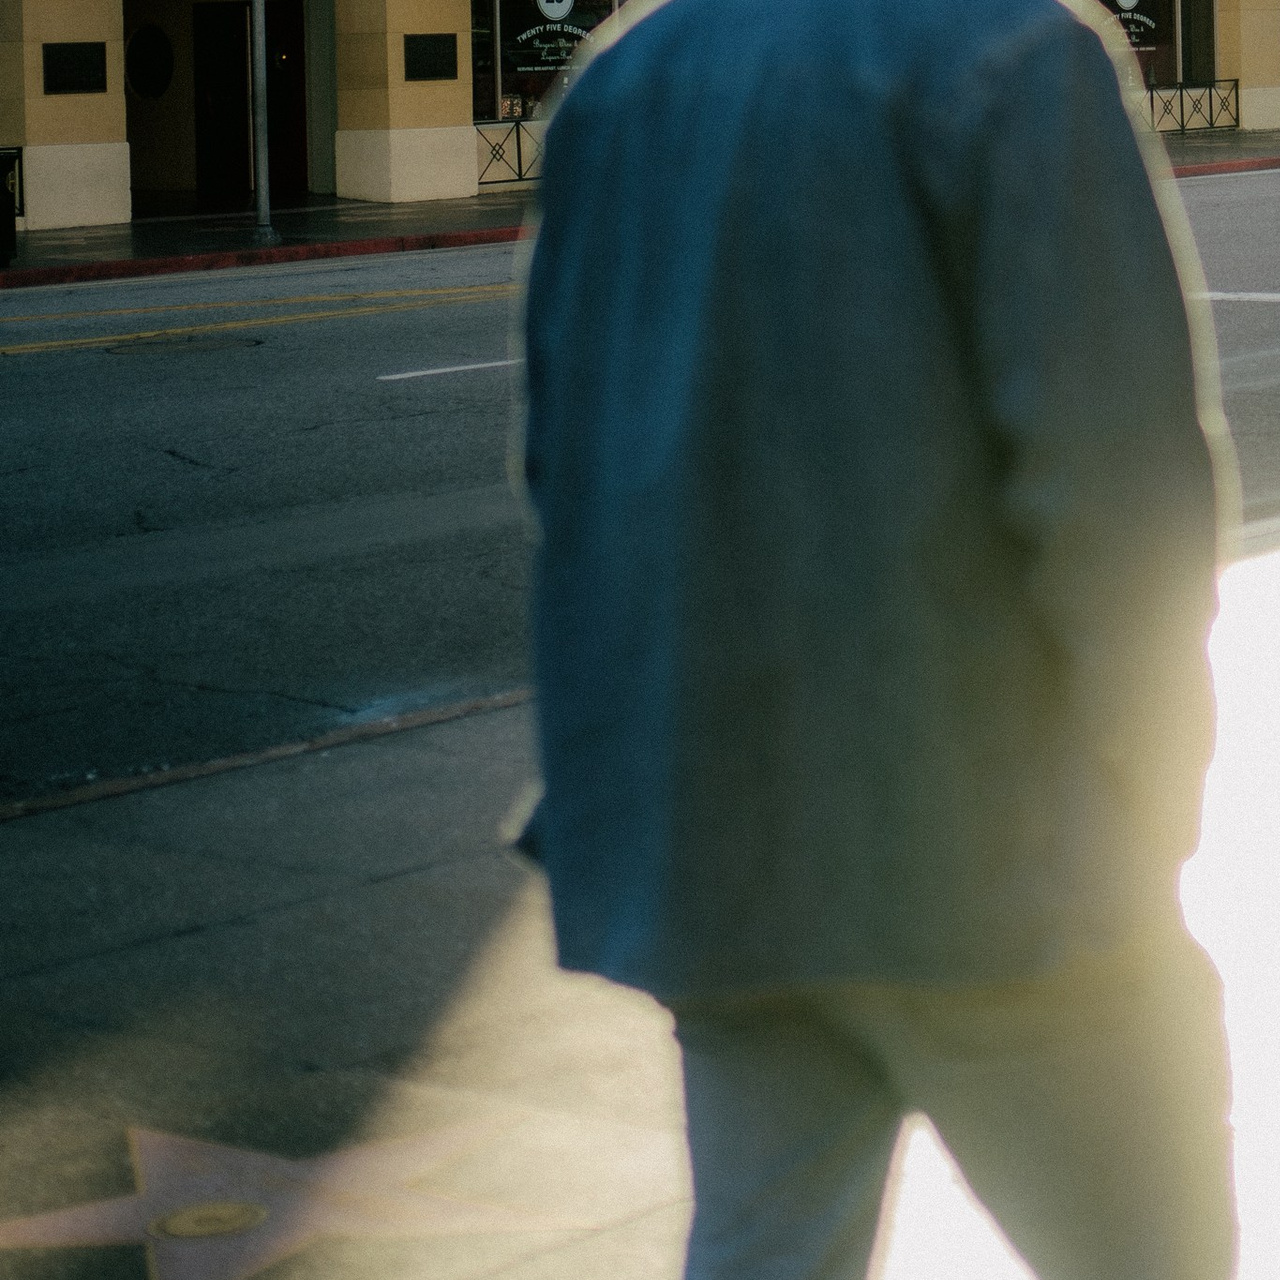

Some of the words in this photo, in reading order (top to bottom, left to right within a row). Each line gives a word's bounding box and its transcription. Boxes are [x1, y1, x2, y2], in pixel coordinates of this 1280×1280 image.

[1120, 12, 1132, 20] FIVE
[516, 25, 545, 43] TWENTY
[545, 23, 562, 32] FIVE
